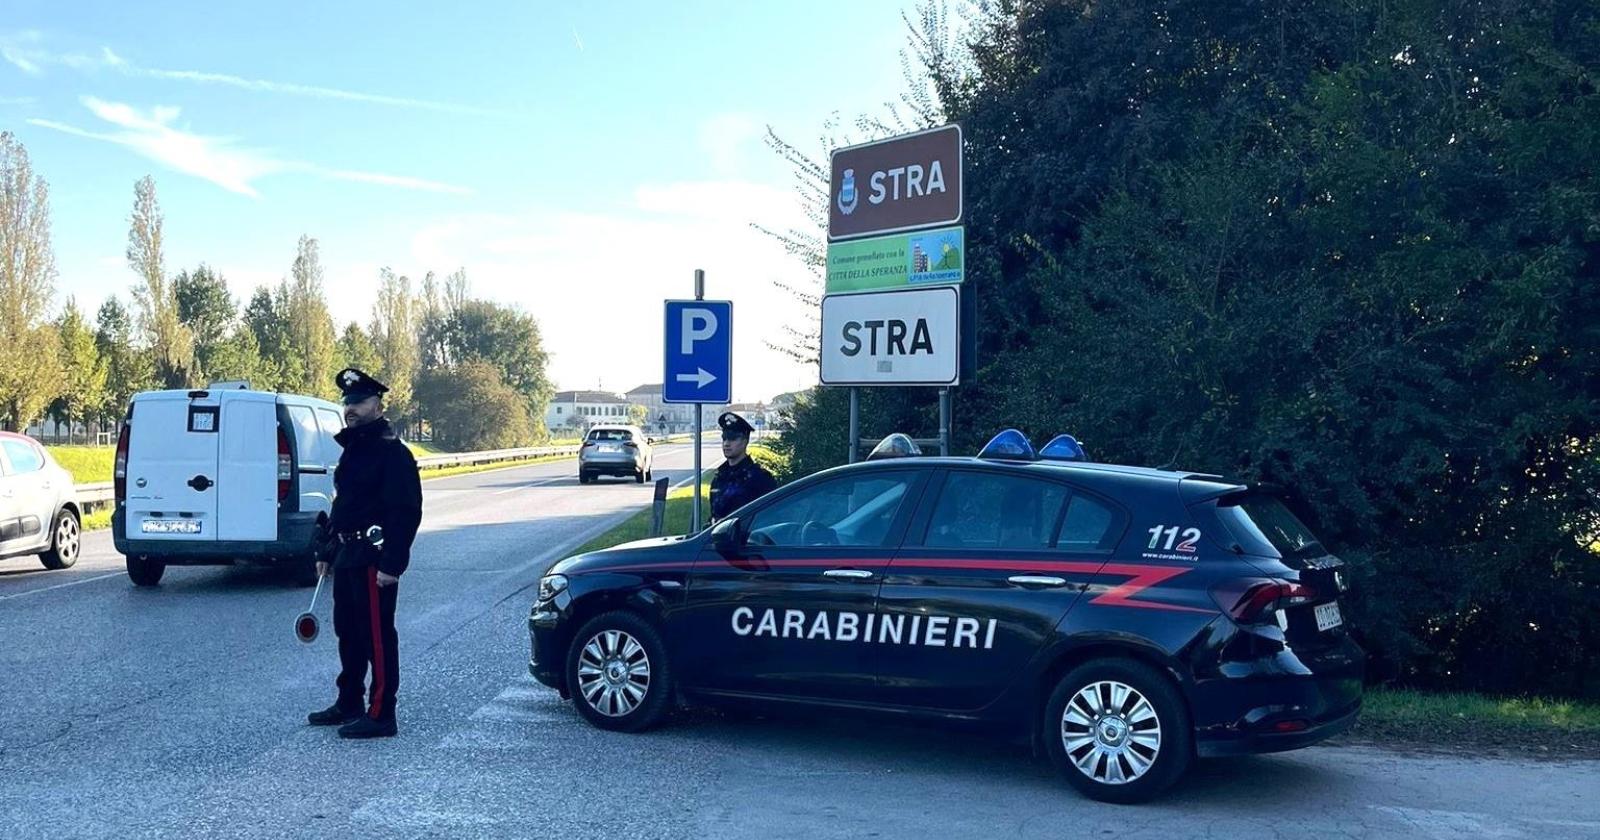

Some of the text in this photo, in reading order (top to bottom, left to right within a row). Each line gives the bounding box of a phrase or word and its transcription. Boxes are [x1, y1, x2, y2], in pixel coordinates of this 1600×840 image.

[868, 160, 946, 205] STRA
[848, 269, 870, 279] DELLA
[872, 265, 908, 277] SPERANZA
[681, 308, 718, 354] P
[840, 318, 934, 357] STRA
[1148, 525, 1202, 552] 112
[731, 606, 998, 649] CARABINIERI
